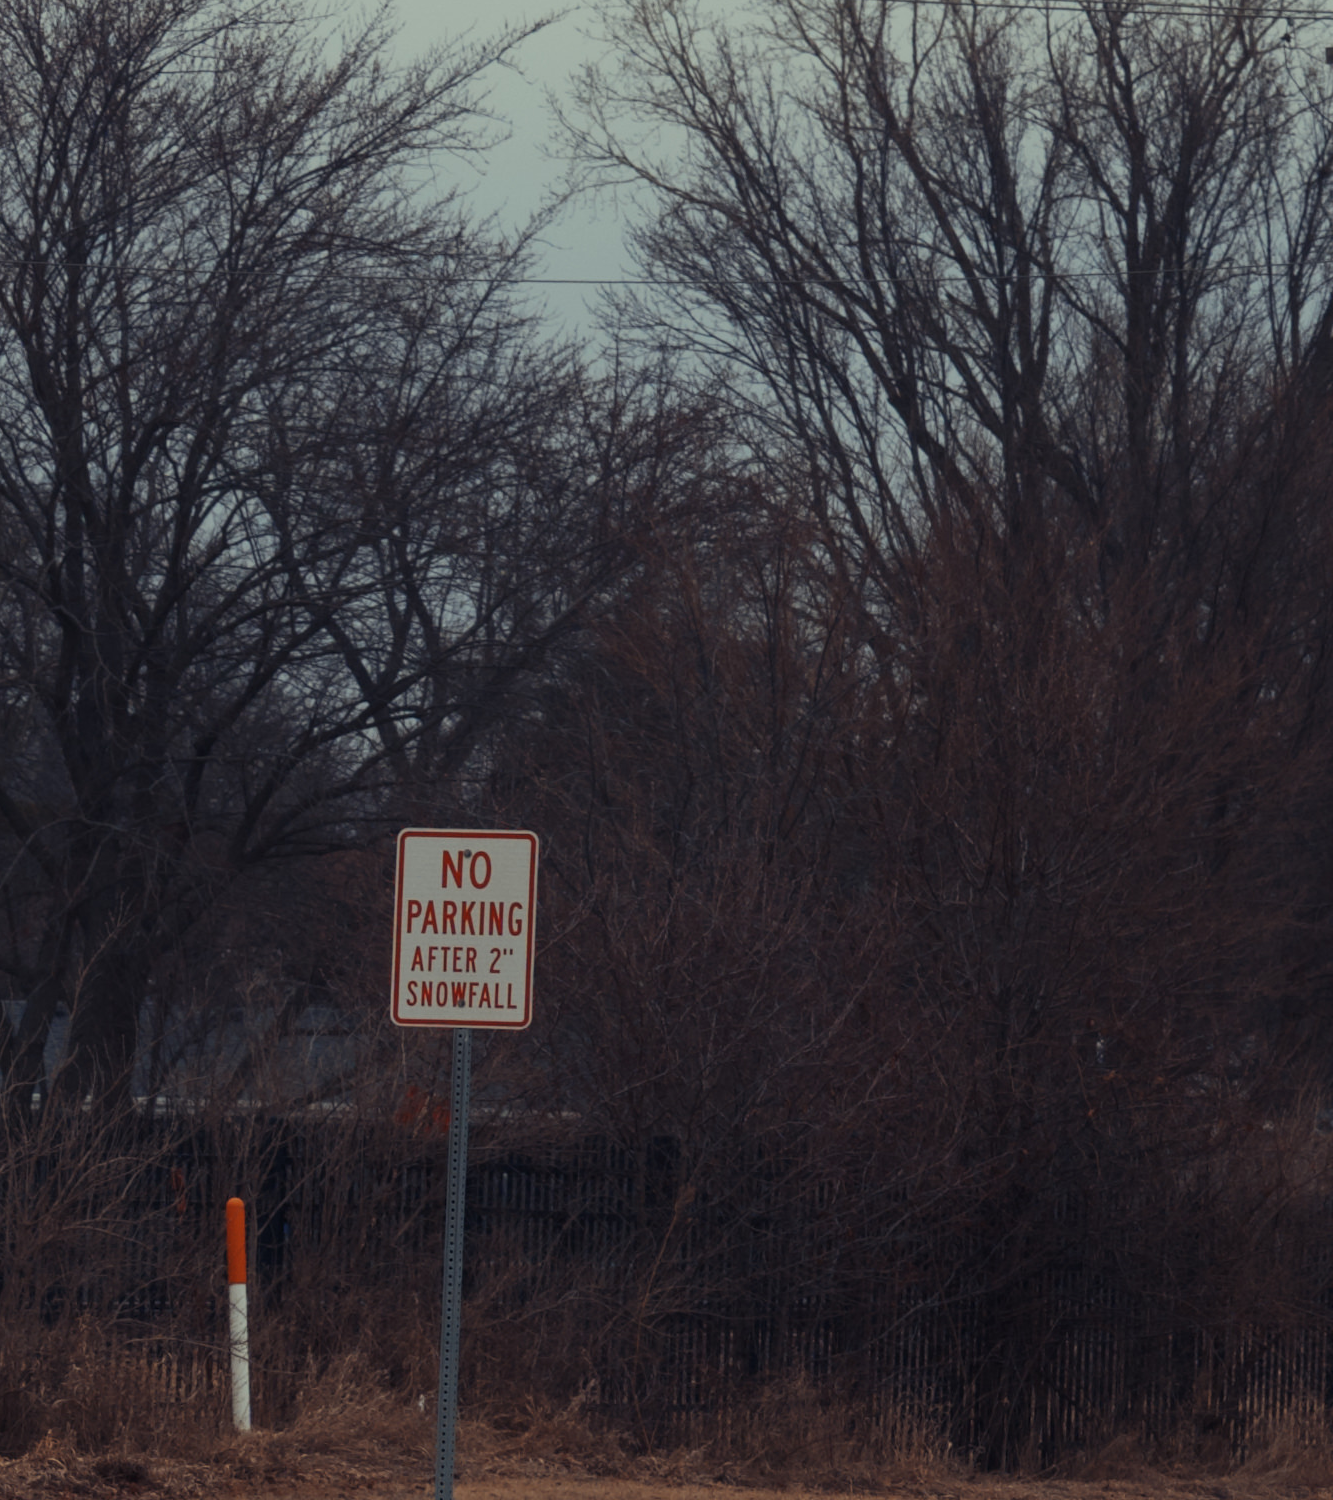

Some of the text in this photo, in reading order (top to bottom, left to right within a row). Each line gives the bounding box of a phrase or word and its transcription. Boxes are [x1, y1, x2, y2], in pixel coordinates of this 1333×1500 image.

[441, 850, 492, 890] NO
[406, 900, 523, 936] PARKING
[410, 945, 514, 974] AFTER 2"
[406, 980, 518, 1010] SNOWFALL
